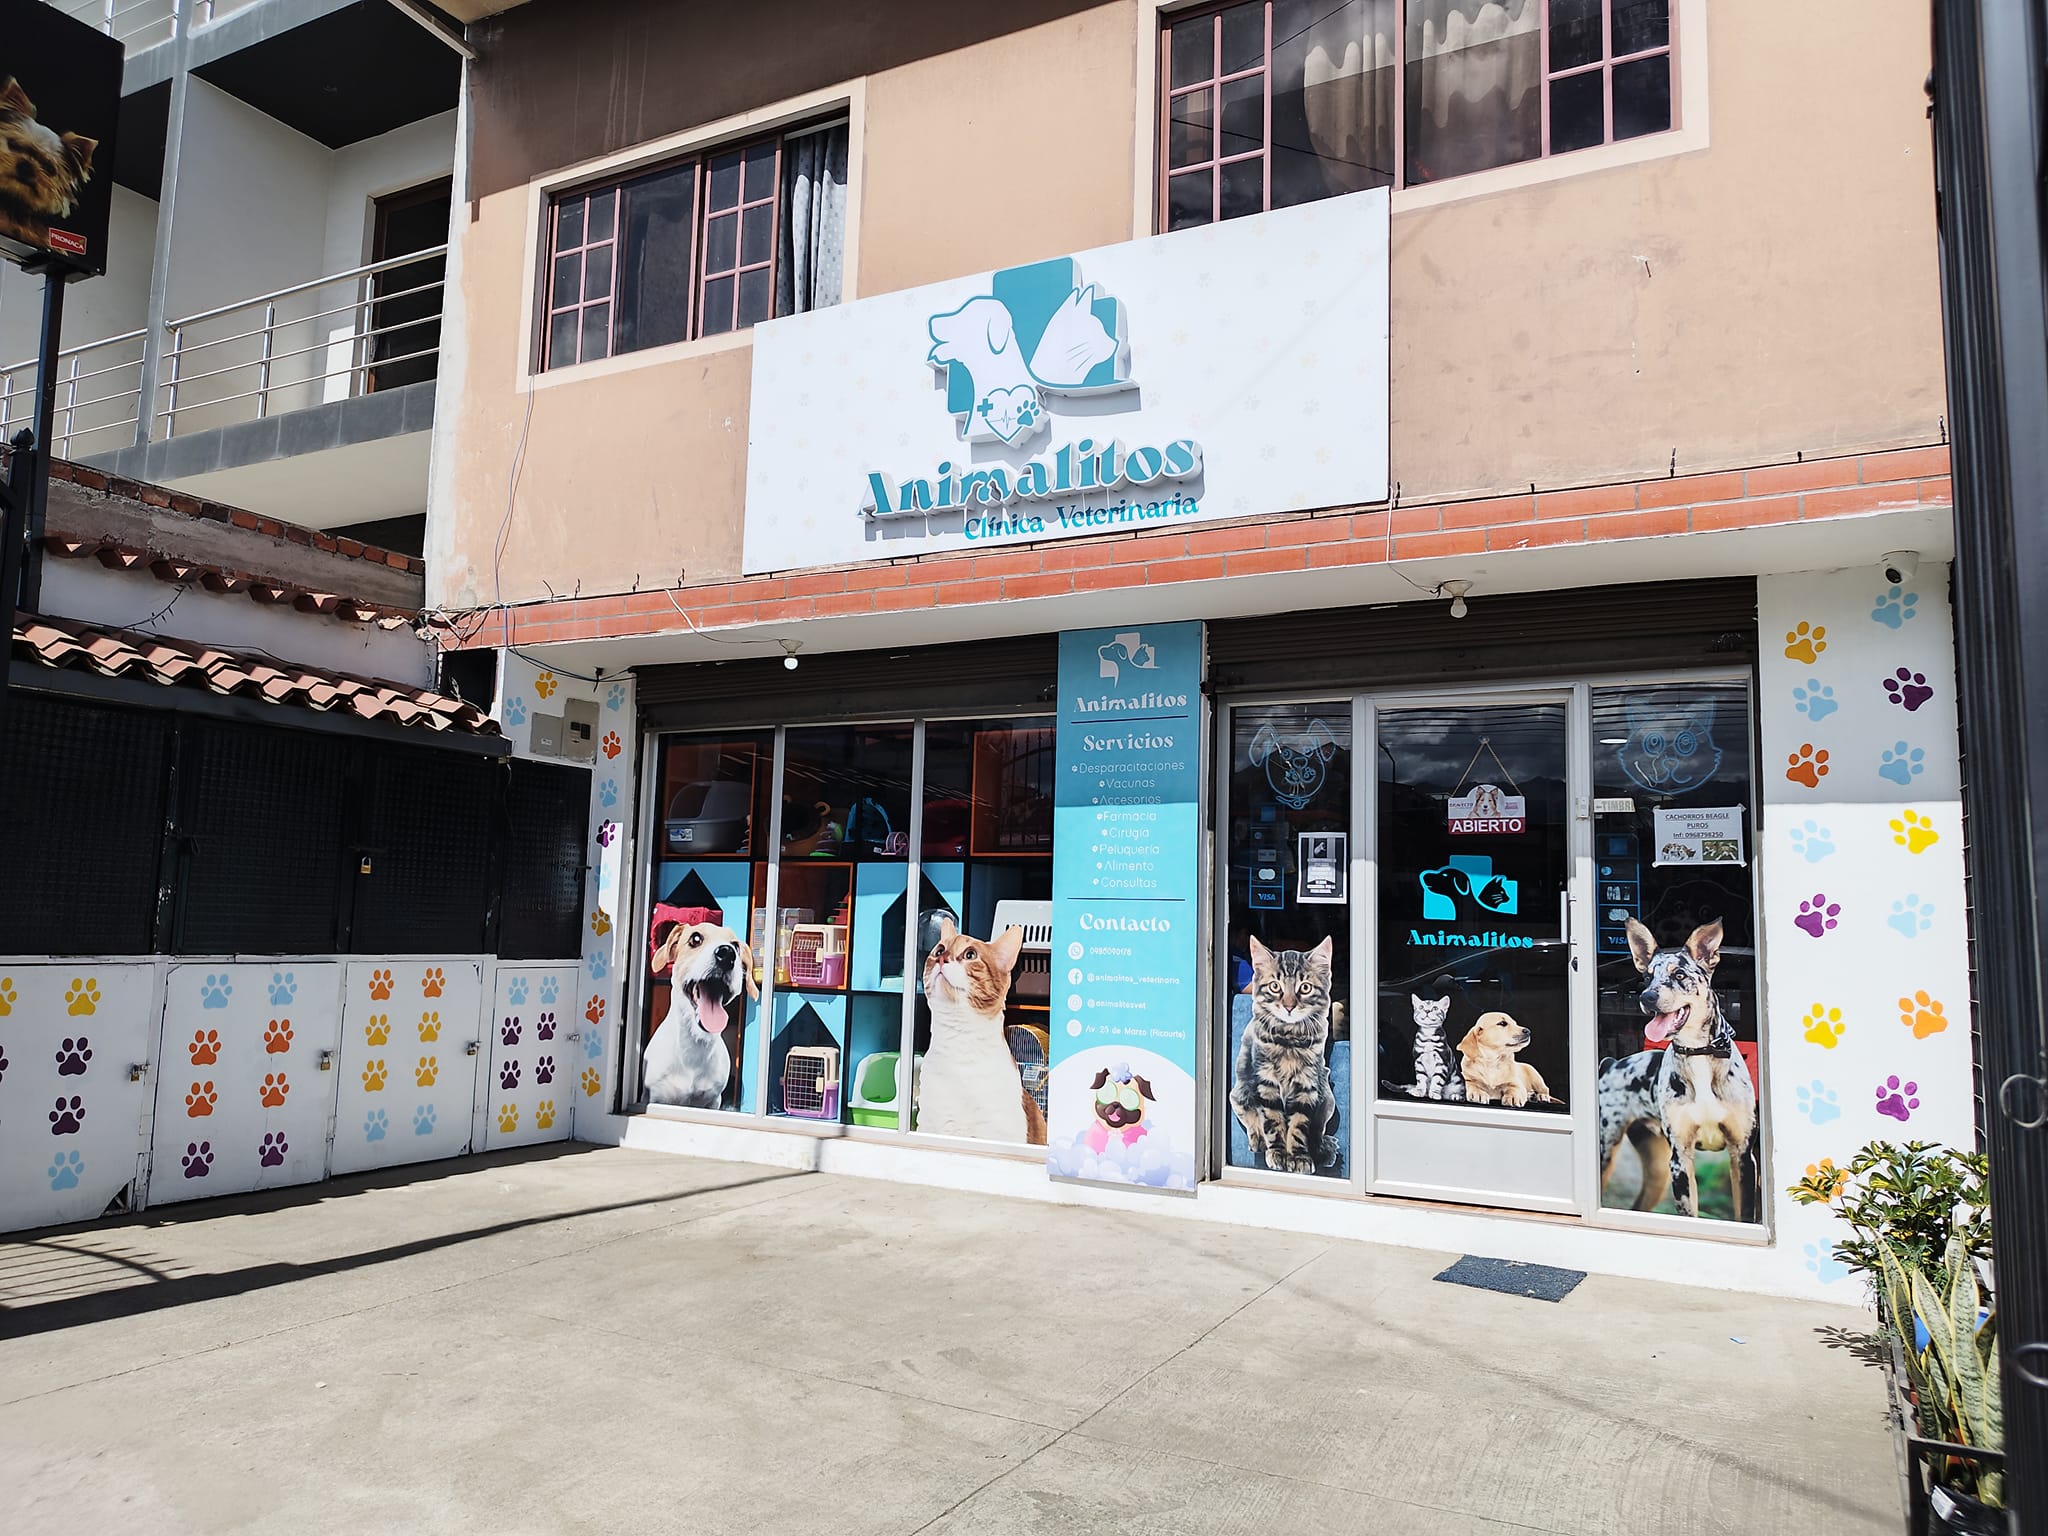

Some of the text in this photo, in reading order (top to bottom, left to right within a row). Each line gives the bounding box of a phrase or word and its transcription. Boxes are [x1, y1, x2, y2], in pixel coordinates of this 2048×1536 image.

[51, 232, 84, 250] PRONACA
[857, 438, 1200, 517] Animalitos
[964, 491, 1199, 540] Clínica Veterinaria
[1073, 692, 1188, 713] Animalitos
[1083, 732, 1174, 752] Servicios
[1079, 761, 1185, 775] Desparacitaciones
[1106, 778, 1156, 789] Vacunas
[1099, 794, 1161, 806] Accesorios
[1103, 811, 1157, 821] Farmacia
[1665, 812, 1729, 821] CACHORROS BEAGLE
[1451, 818, 1523, 833] ABIERTO
[1686, 822, 1710, 830] PUROS
[1104, 860, 1155, 872] Alimento
[1100, 876, 1158, 889] Consultas
[1258, 893, 1276, 901] VISA
[1079, 912, 1171, 933] Contacto
[1406, 929, 1534, 949] Animalitos
